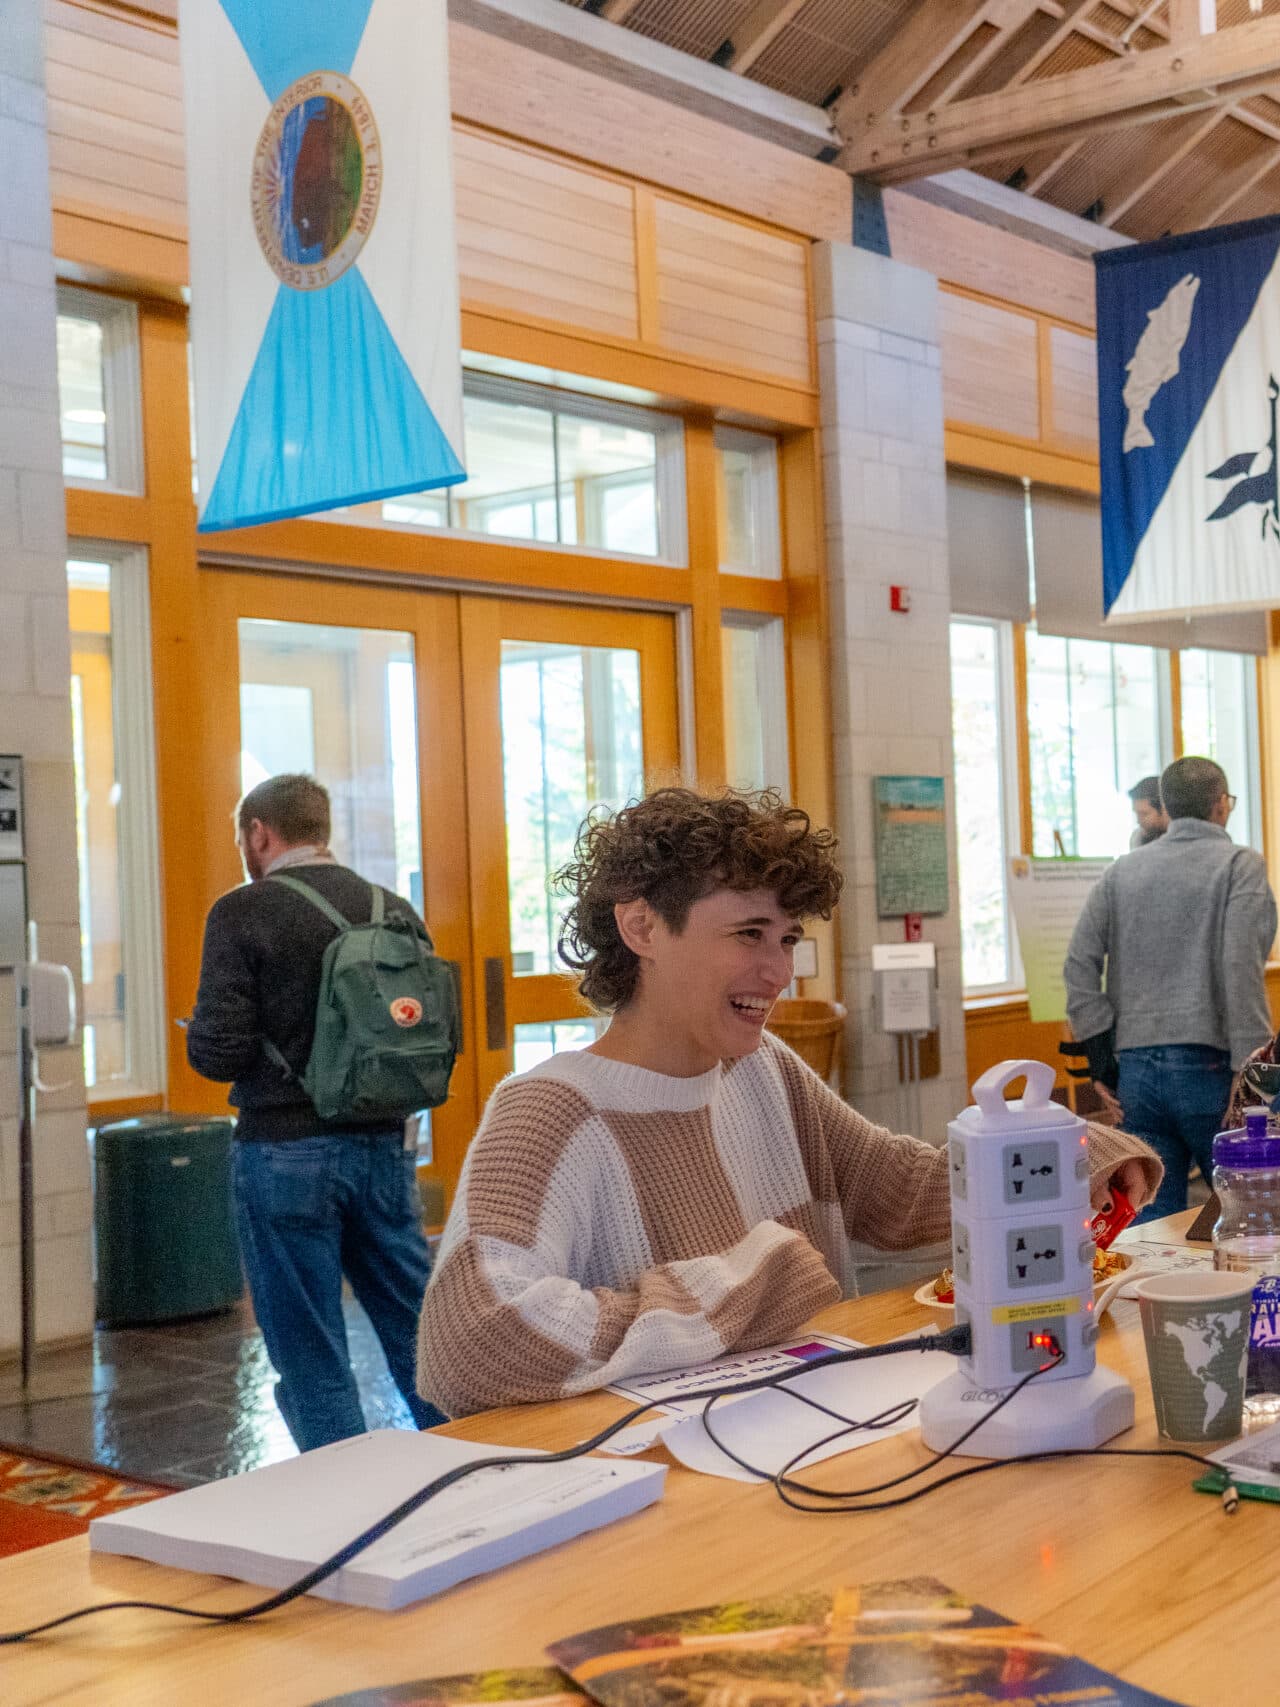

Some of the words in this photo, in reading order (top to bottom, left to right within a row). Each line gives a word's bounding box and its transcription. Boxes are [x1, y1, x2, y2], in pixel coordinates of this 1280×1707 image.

[355, 166, 378, 236] MARCH
[747, 1353, 785, 1365] For
[749, 1358, 800, 1374] Safe
[636, 1361, 745, 1389] Everyone
[674, 1371, 748, 1391] Space
